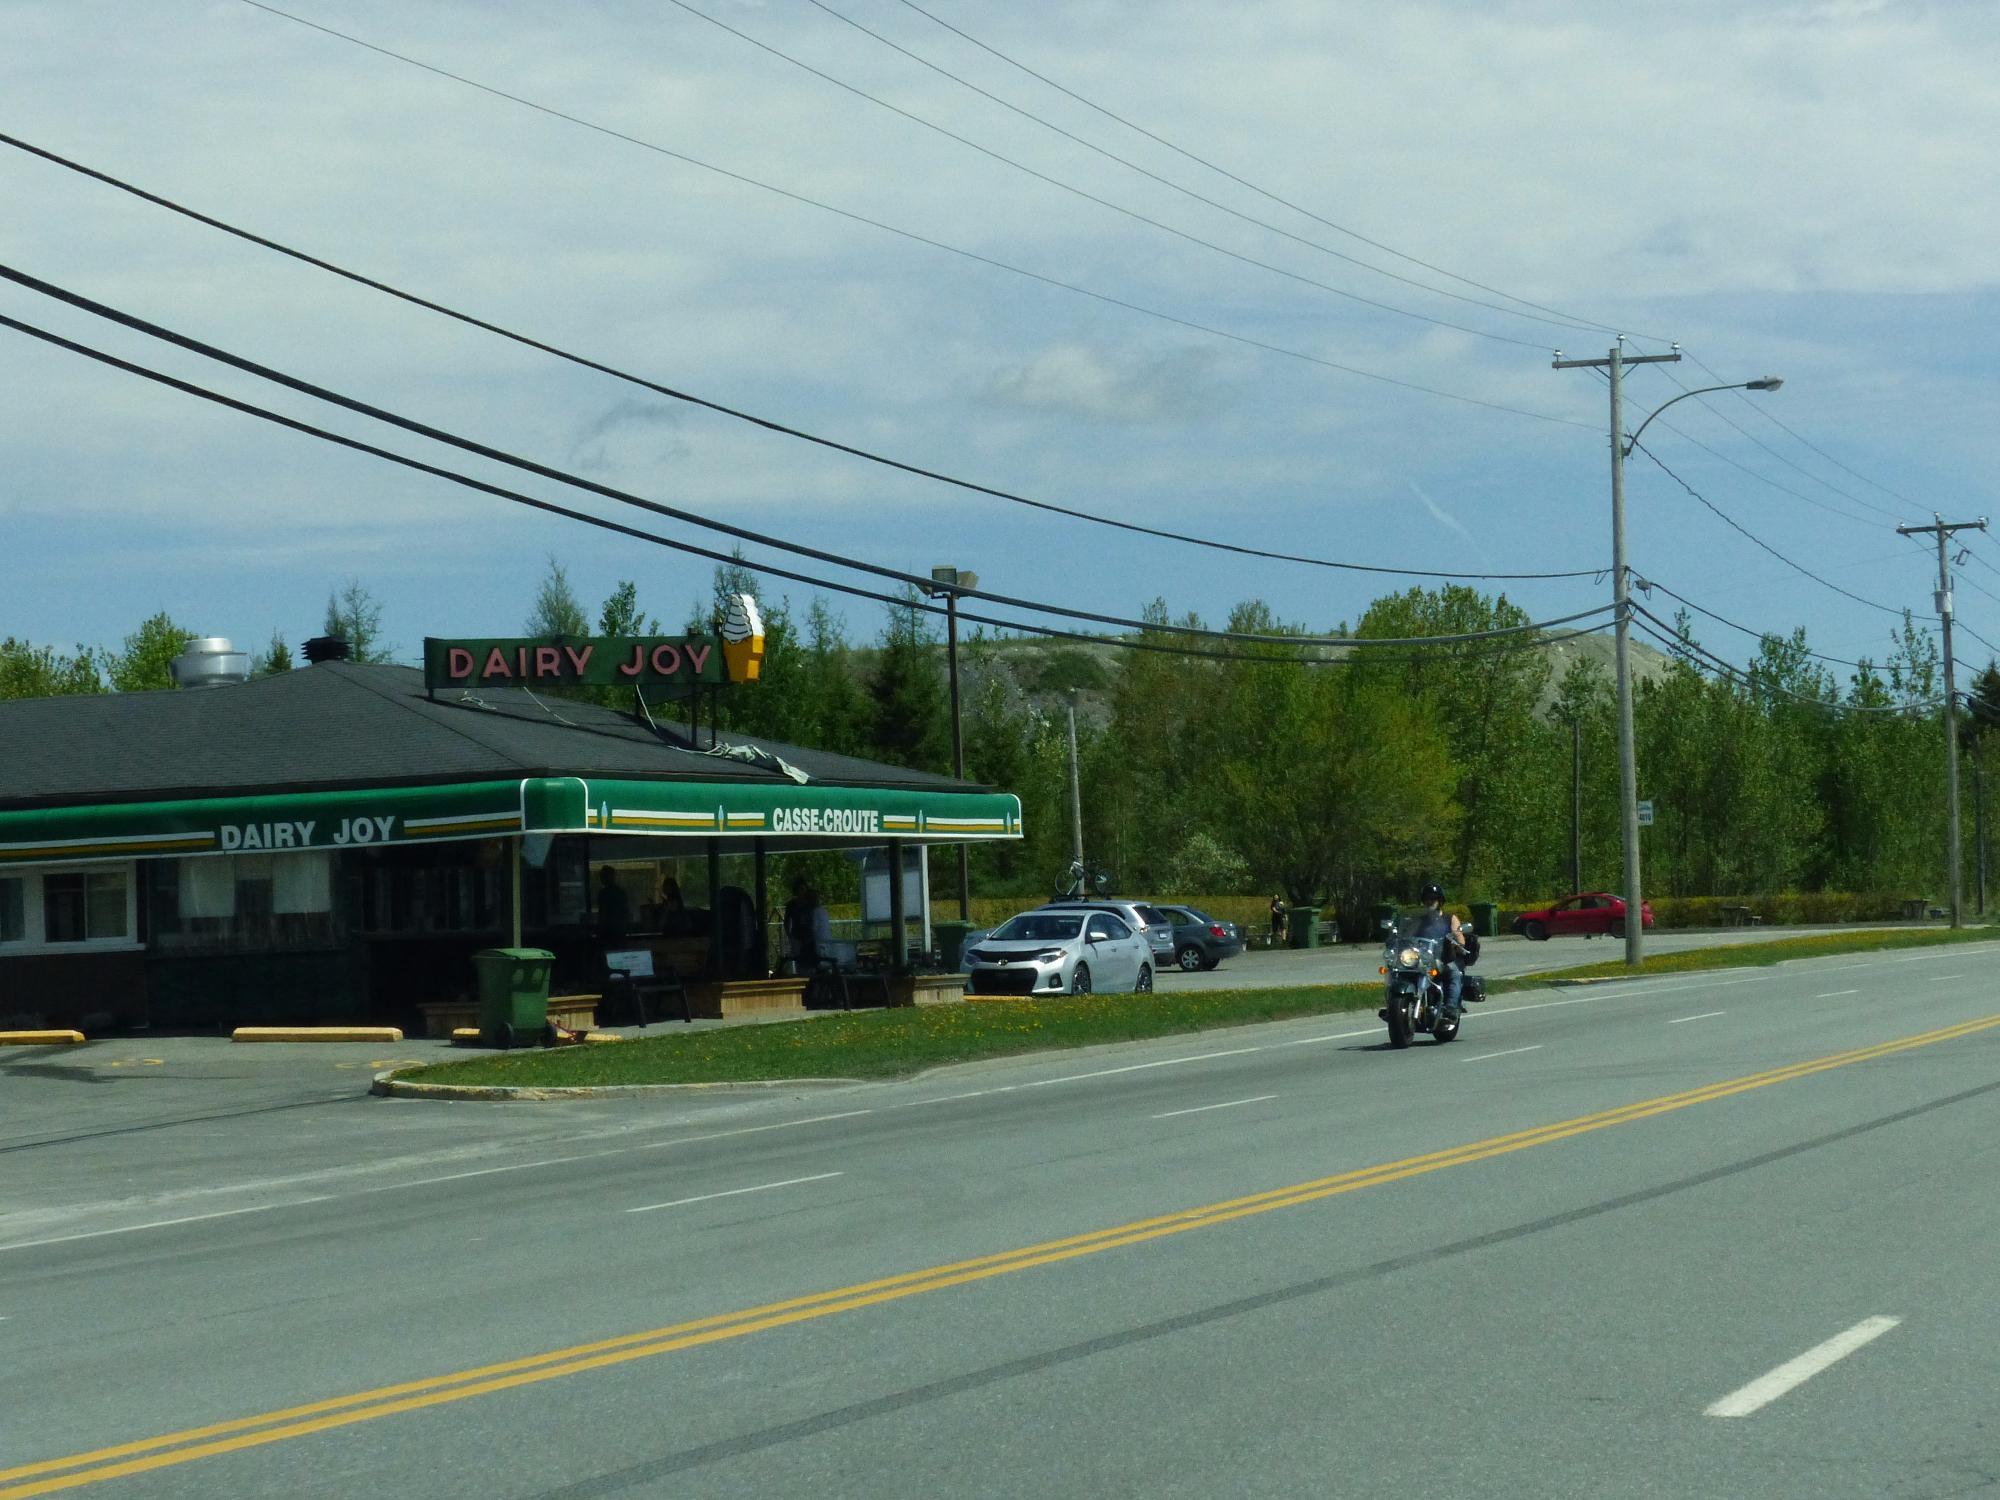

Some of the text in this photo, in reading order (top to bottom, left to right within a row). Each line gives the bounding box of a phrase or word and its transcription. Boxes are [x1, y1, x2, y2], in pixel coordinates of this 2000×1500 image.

[449, 644, 711, 678] DAIRY JOY
[221, 816, 395, 849] DAIRY JOY
[773, 807, 879, 832] CASSE-CROUTE
